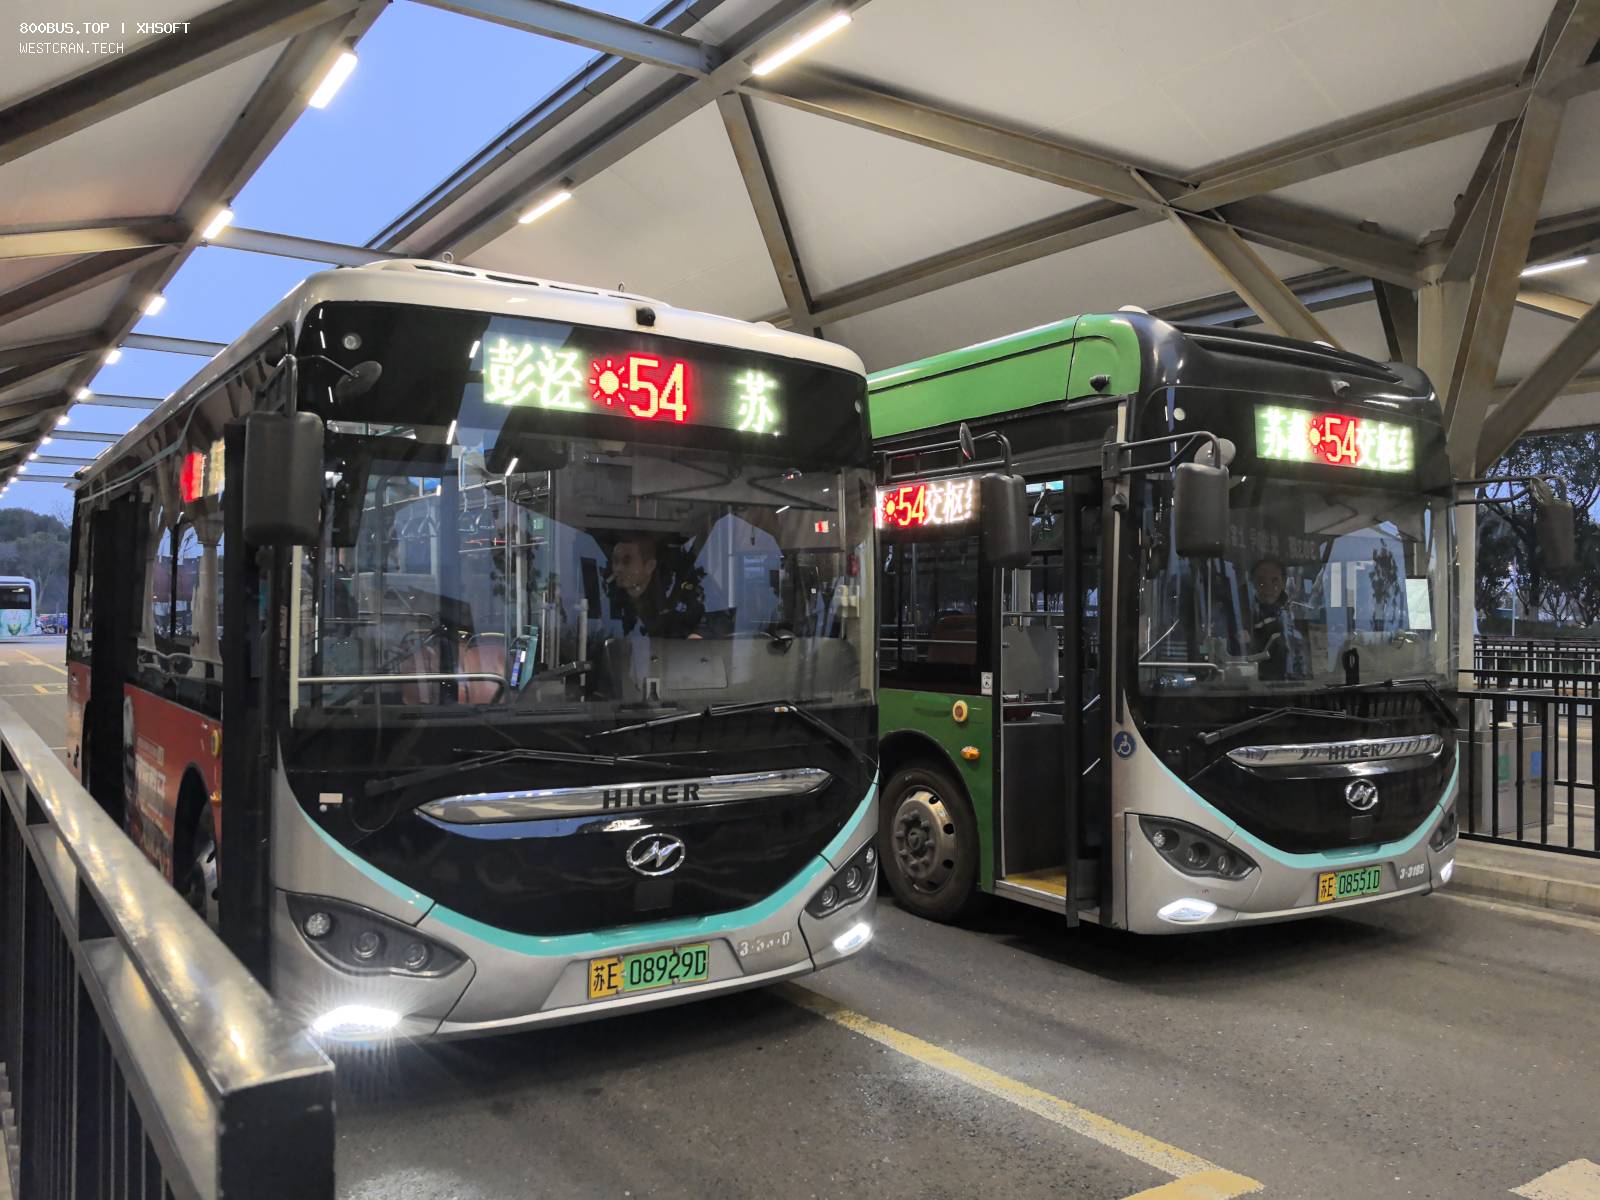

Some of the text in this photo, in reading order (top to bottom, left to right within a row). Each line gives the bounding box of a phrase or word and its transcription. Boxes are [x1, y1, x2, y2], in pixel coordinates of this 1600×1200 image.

[485, 338, 780, 434] 彭泾 54 苏
[1325, 417, 1358, 464] 54
[898, 485, 925, 526] 54
[1328, 743, 1380, 760] HIGER
[602, 782, 701, 810] HIGER
[1338, 869, 1381, 895] 08551D
[630, 950, 707, 986] 08929D
